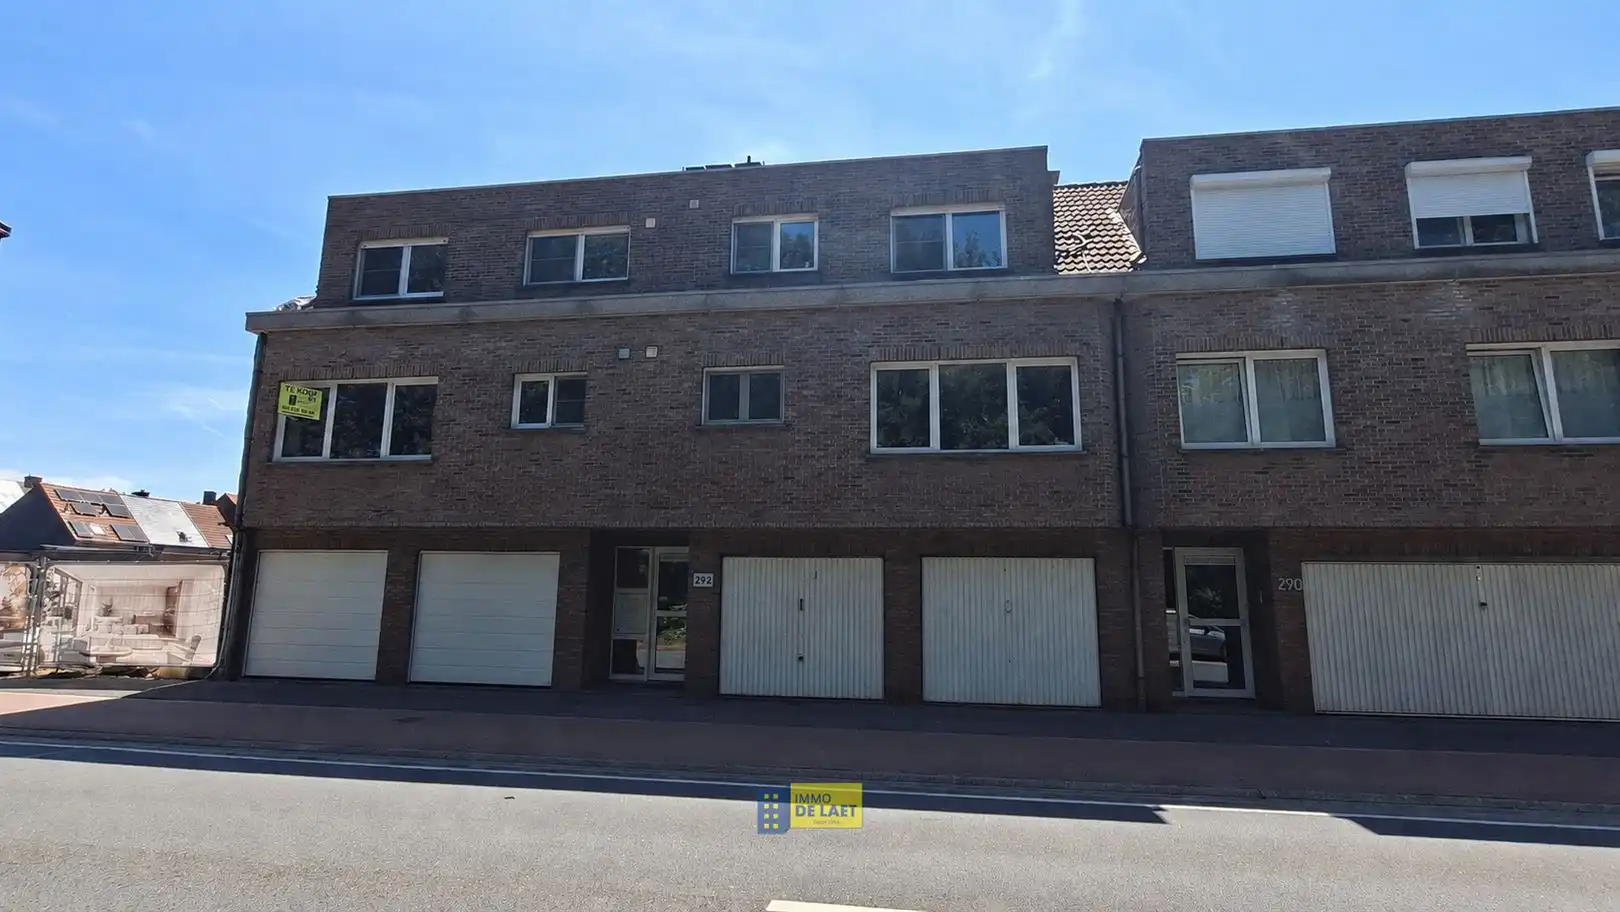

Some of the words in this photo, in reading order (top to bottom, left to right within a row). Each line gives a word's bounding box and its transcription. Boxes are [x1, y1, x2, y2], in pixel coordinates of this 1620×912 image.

[285, 385, 295, 393] TE
[695, 576, 712, 585] 292
[1278, 578, 1303, 591] 290
